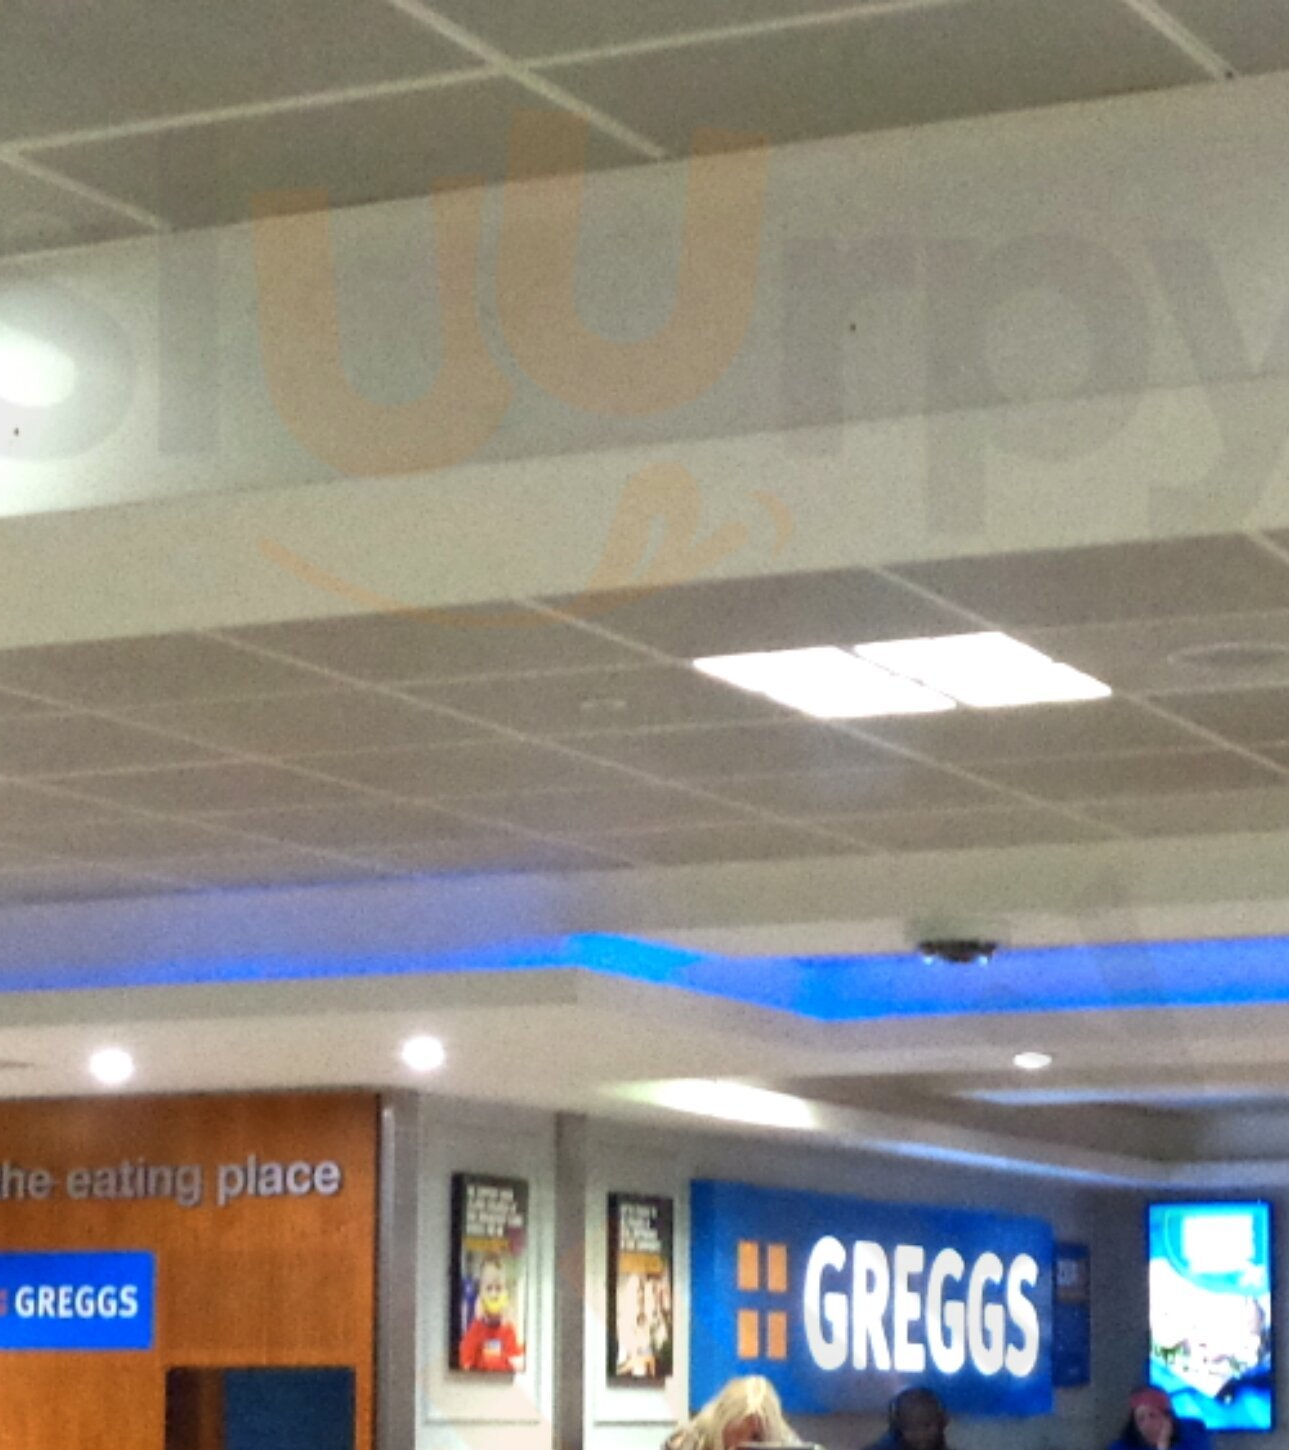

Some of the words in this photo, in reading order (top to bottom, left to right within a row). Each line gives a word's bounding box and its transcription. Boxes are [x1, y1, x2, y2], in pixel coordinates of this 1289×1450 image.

[66, 1157, 204, 1206] eating
[216, 1154, 342, 1206] place
[13, 1284, 139, 1319] GREGGS
[802, 1234, 1041, 1378] GREGGS
